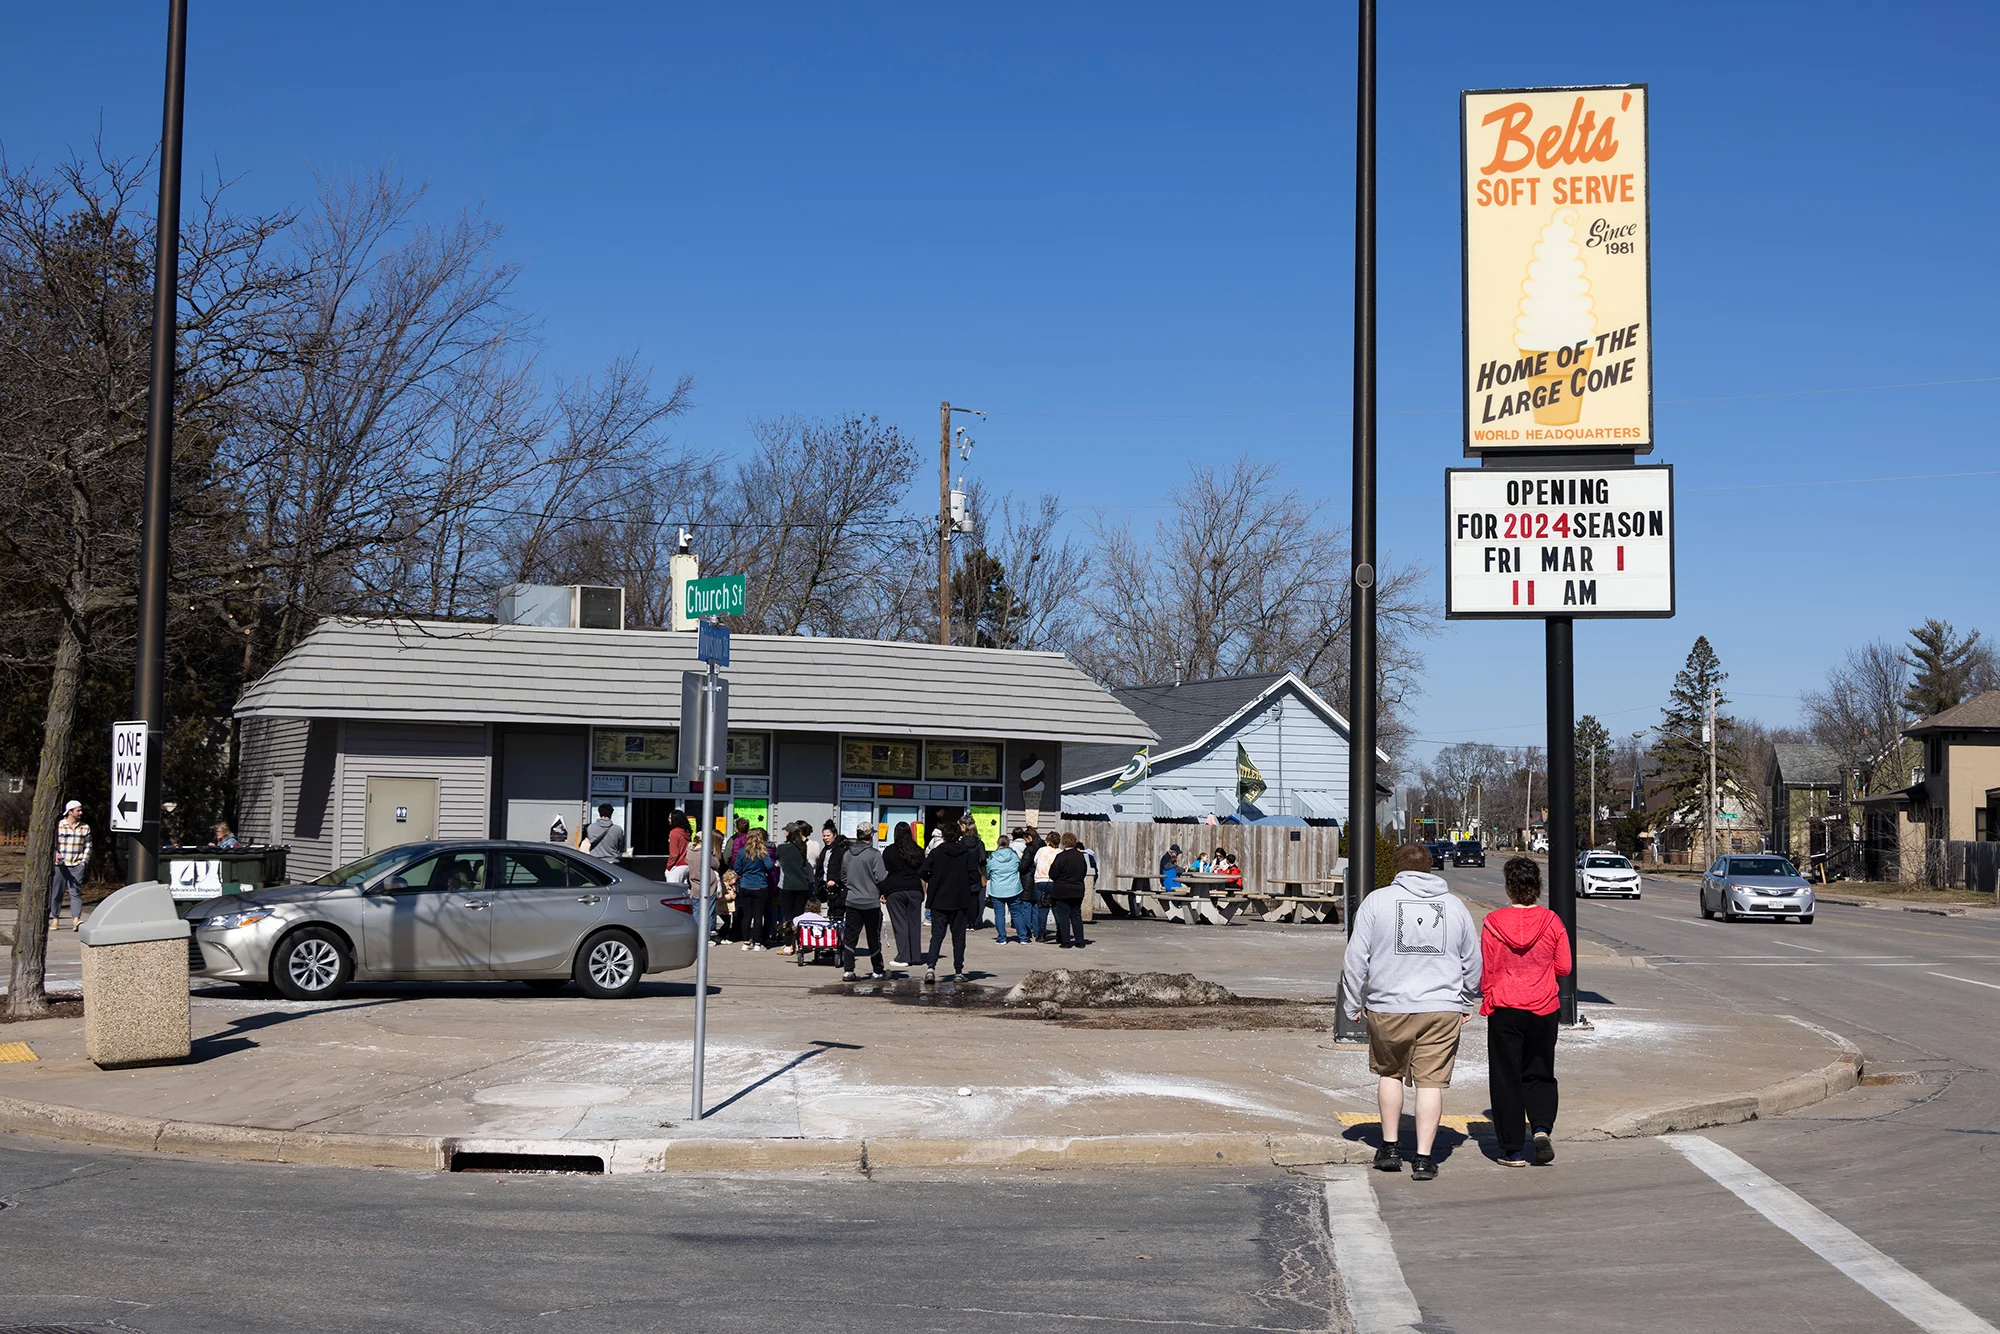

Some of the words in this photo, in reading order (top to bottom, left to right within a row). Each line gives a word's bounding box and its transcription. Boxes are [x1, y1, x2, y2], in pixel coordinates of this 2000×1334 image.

[1480, 92, 1632, 176] Belts'
[1476, 177, 1541, 207] SOFT
[1553, 174, 1635, 205] SERVE
[1586, 218, 1637, 248] Since
[1605, 242, 1634, 255] 1981
[1476, 351, 1549, 392] HOME
[1556, 339, 1588, 368] OF
[1596, 323, 1640, 357] THE
[1481, 379, 1563, 424] LARGE
[1570, 357, 1636, 398] CONE
[1474, 429, 1520, 441] WORLD
[1526, 427, 1641, 440] HEADQUARTERS
[1507, 479, 1609, 506] OPENING
[1457, 513, 1498, 539] FOR
[1504, 512, 1571, 539] 2024
[1573, 510, 1663, 539] SEASON
[1485, 546, 1520, 573] FRI
[1541, 546, 1593, 572] MAR
[687, 583, 729, 613] Church
[732, 584, 742, 606] St
[1563, 579, 1597, 606] AM
[117, 732, 142, 757] ONE
[116, 762, 142, 787] WAY
